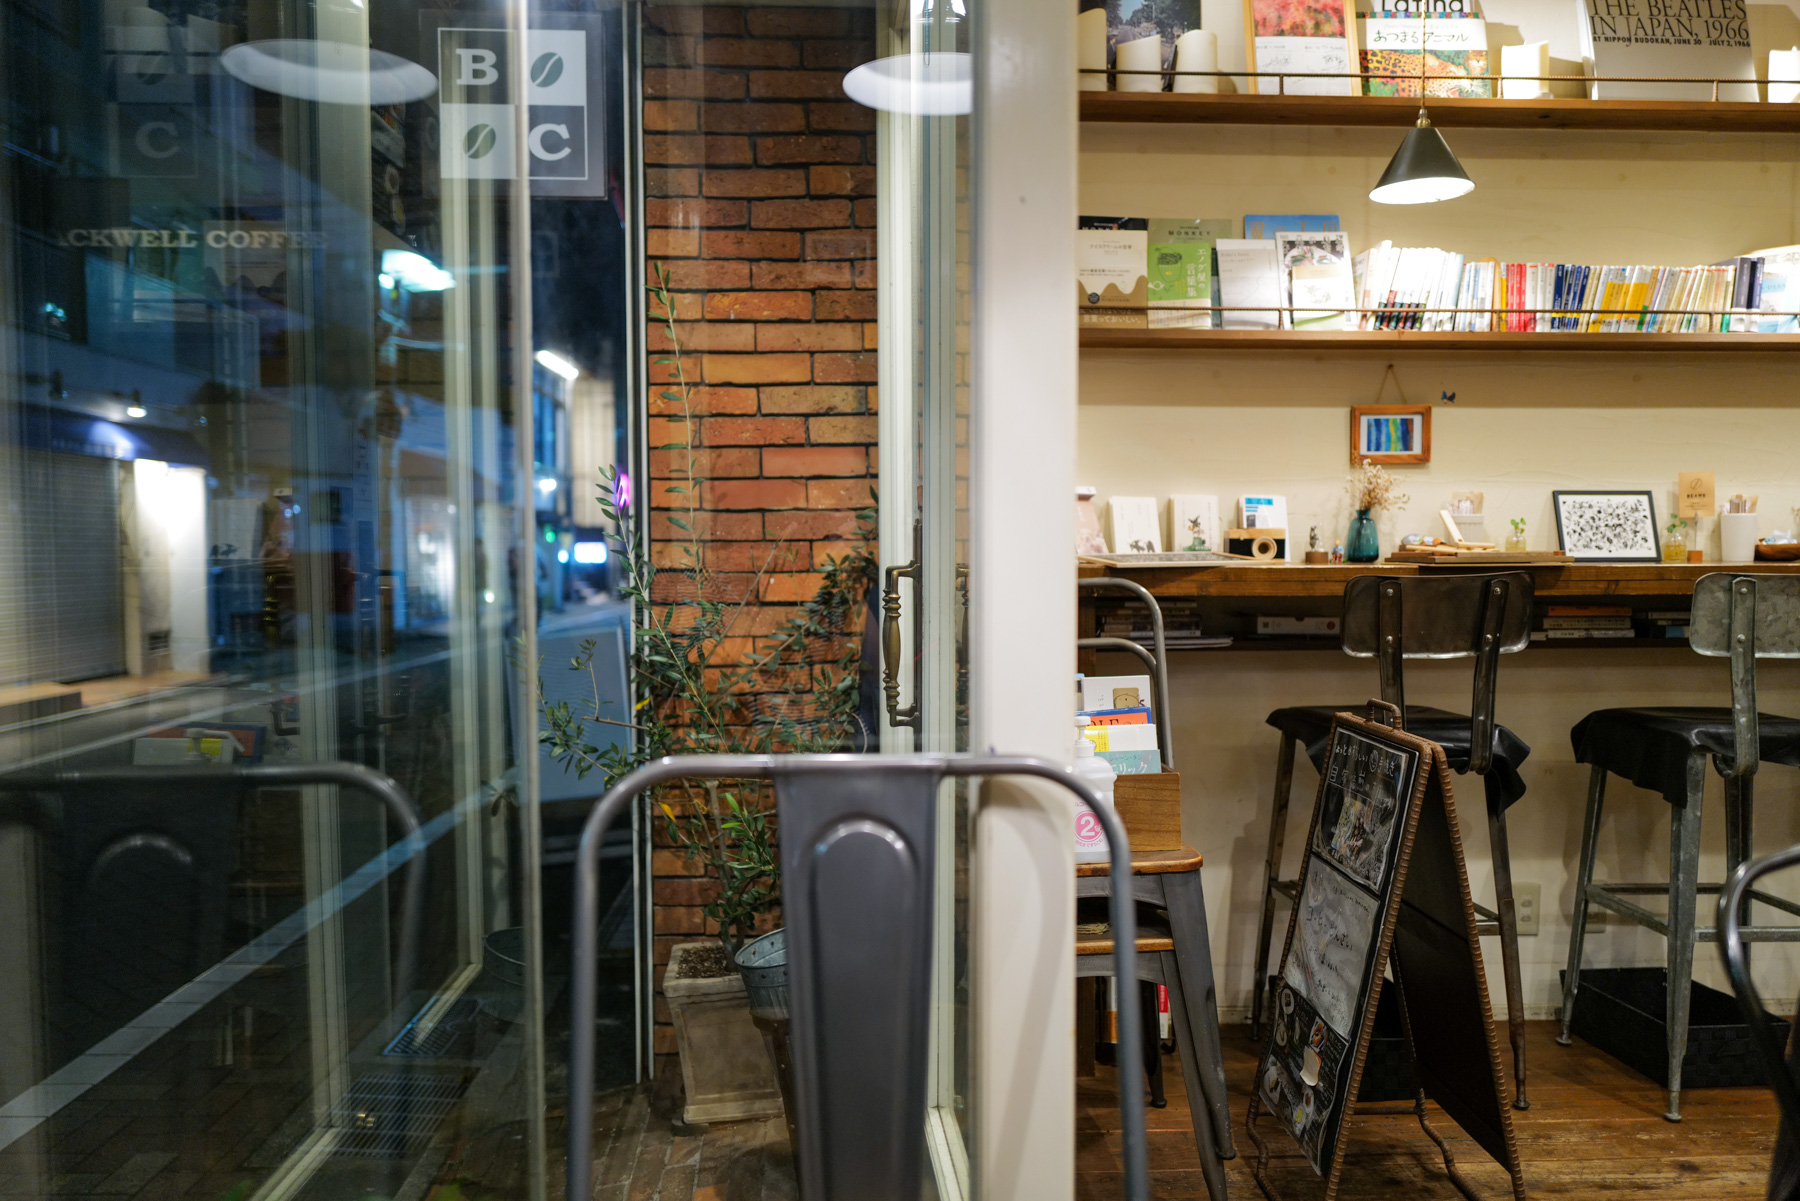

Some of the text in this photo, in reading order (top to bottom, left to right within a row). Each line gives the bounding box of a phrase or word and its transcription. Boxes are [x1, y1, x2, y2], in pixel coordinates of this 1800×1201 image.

[1590, 0, 1747, 20] THE BEATLES
[1590, 16, 1750, 46] IN JAPAN, 1966
[1634, 37, 1672, 45] BUDOKAN,
[1735, 40, 1751, 48] 1966
[455, 48, 499, 86] B
[528, 123, 572, 162] C
[1080, 815, 1096, 837] 2
